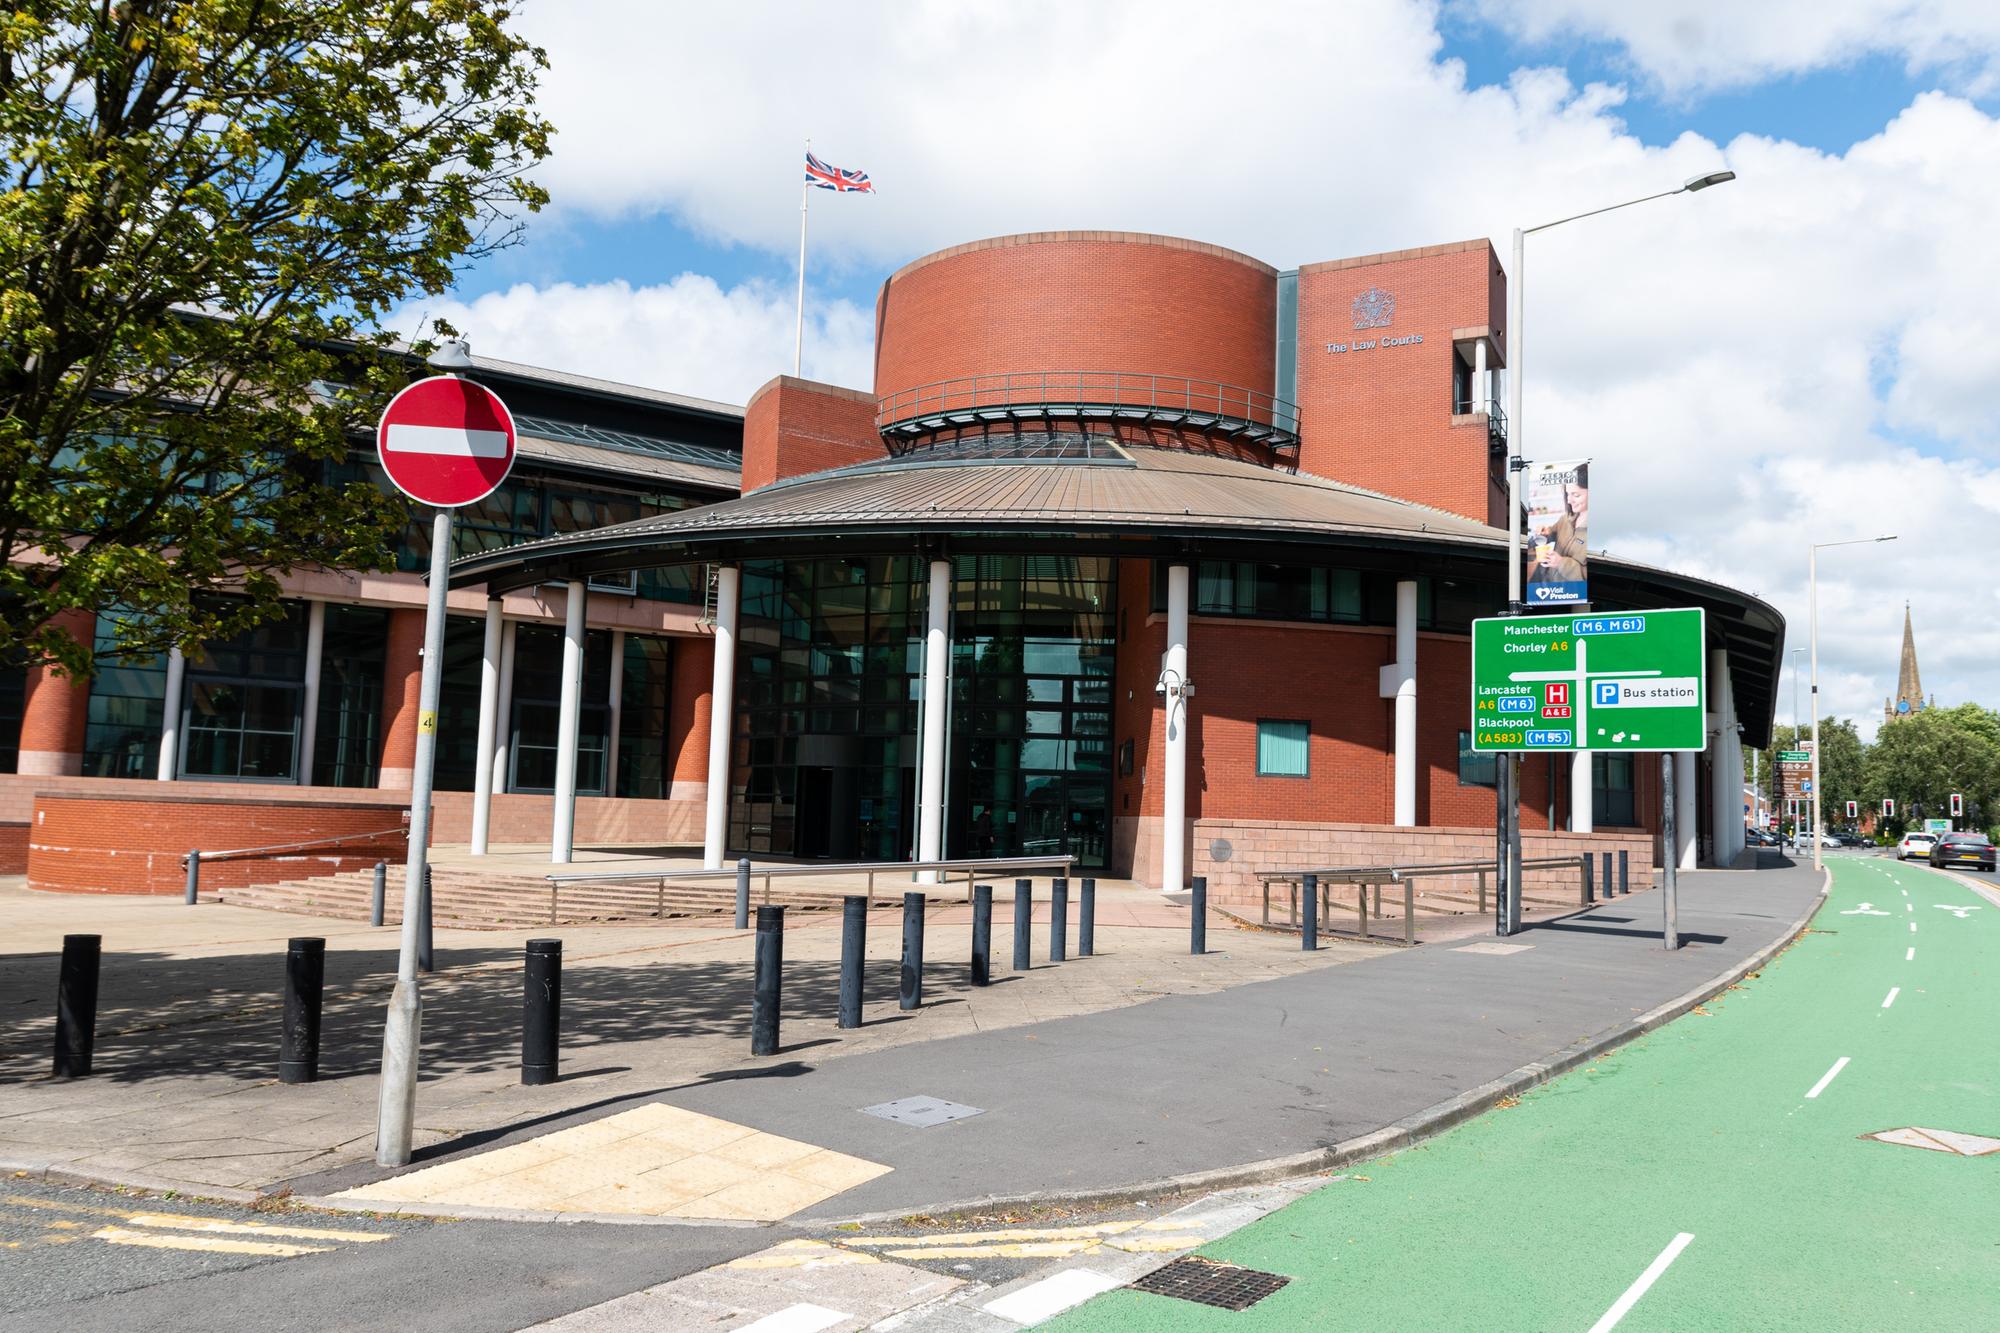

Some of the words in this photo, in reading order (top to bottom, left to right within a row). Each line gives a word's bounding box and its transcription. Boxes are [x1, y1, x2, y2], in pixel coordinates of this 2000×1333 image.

[1327, 343, 1347, 354] The
[1352, 340, 1376, 351] Law
[1382, 335, 1423, 347] Courts
[1550, 592, 1578, 600] Preston
[1504, 624, 1569, 636] Manchester
[1504, 642, 1547, 654] Chorley
[1551, 641, 1568, 651] A6
[1478, 685, 1532, 695] Lancaster
[1623, 688, 1647, 698] Bus
[1650, 687, 1694, 697] station
[1478, 701, 1495, 710] A6
[423, 717, 432, 728] 4
[1478, 717, 1534, 729] Blackpool
